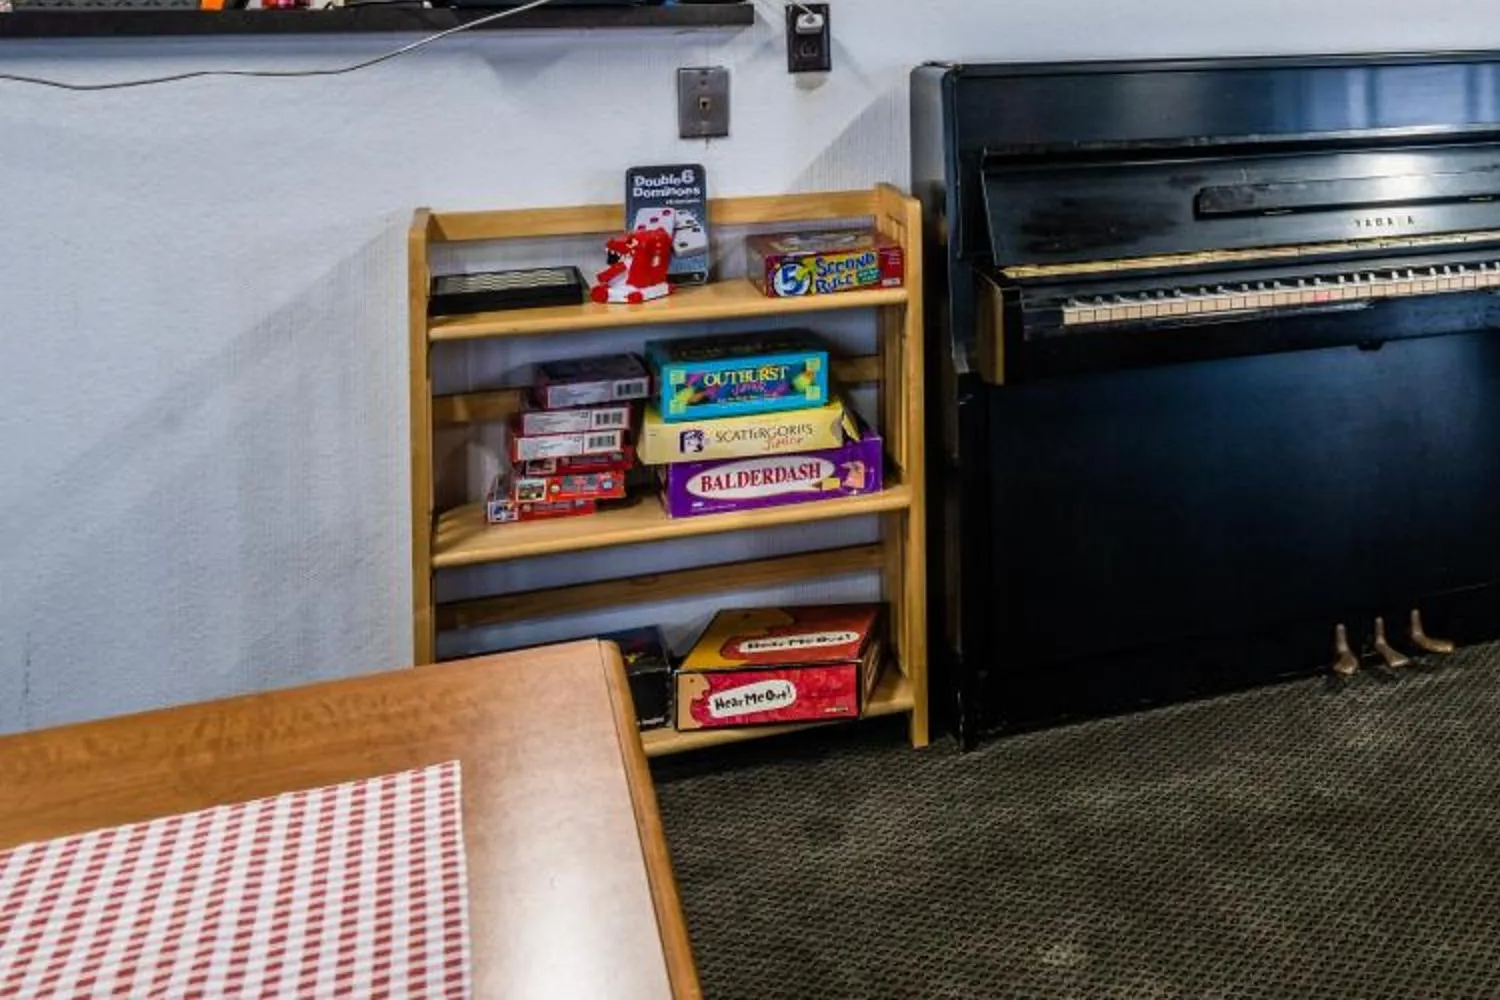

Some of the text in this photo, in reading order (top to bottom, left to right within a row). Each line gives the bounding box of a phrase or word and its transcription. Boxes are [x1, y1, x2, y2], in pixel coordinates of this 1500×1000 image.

[632, 185, 701, 198] Dominoes
[780, 264, 806, 294] 5
[703, 365, 789, 387] OUTBURST
[700, 462, 822, 493] BALDERDASH
[714, 696, 743, 711] Hear
[744, 692, 765, 706] Me
